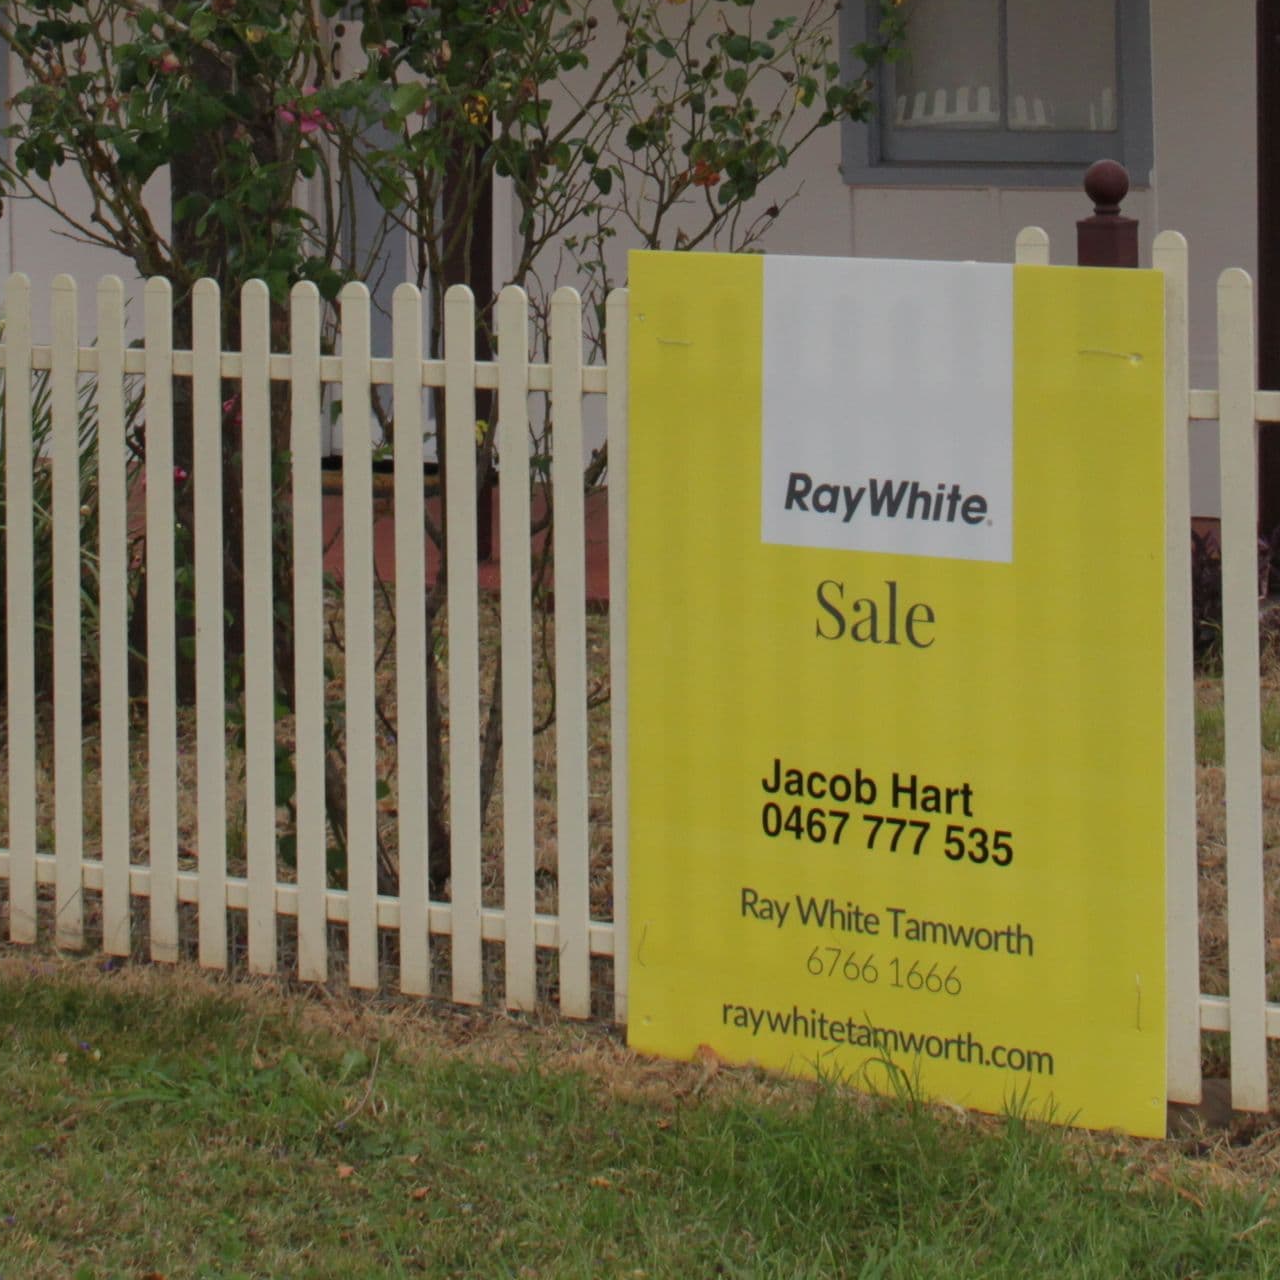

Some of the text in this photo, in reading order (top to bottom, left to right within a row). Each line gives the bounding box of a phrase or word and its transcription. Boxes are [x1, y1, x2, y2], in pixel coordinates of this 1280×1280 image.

[816, 580, 935, 648] Sale
[762, 758, 973, 818] Jacob Hart
[762, 802, 1013, 867] 0467 777 535
[741, 888, 1033, 957] Ray White Tamworth
[807, 946, 962, 996] 6766 1666
[723, 1004, 1054, 1075] raywhitetamworth.com
